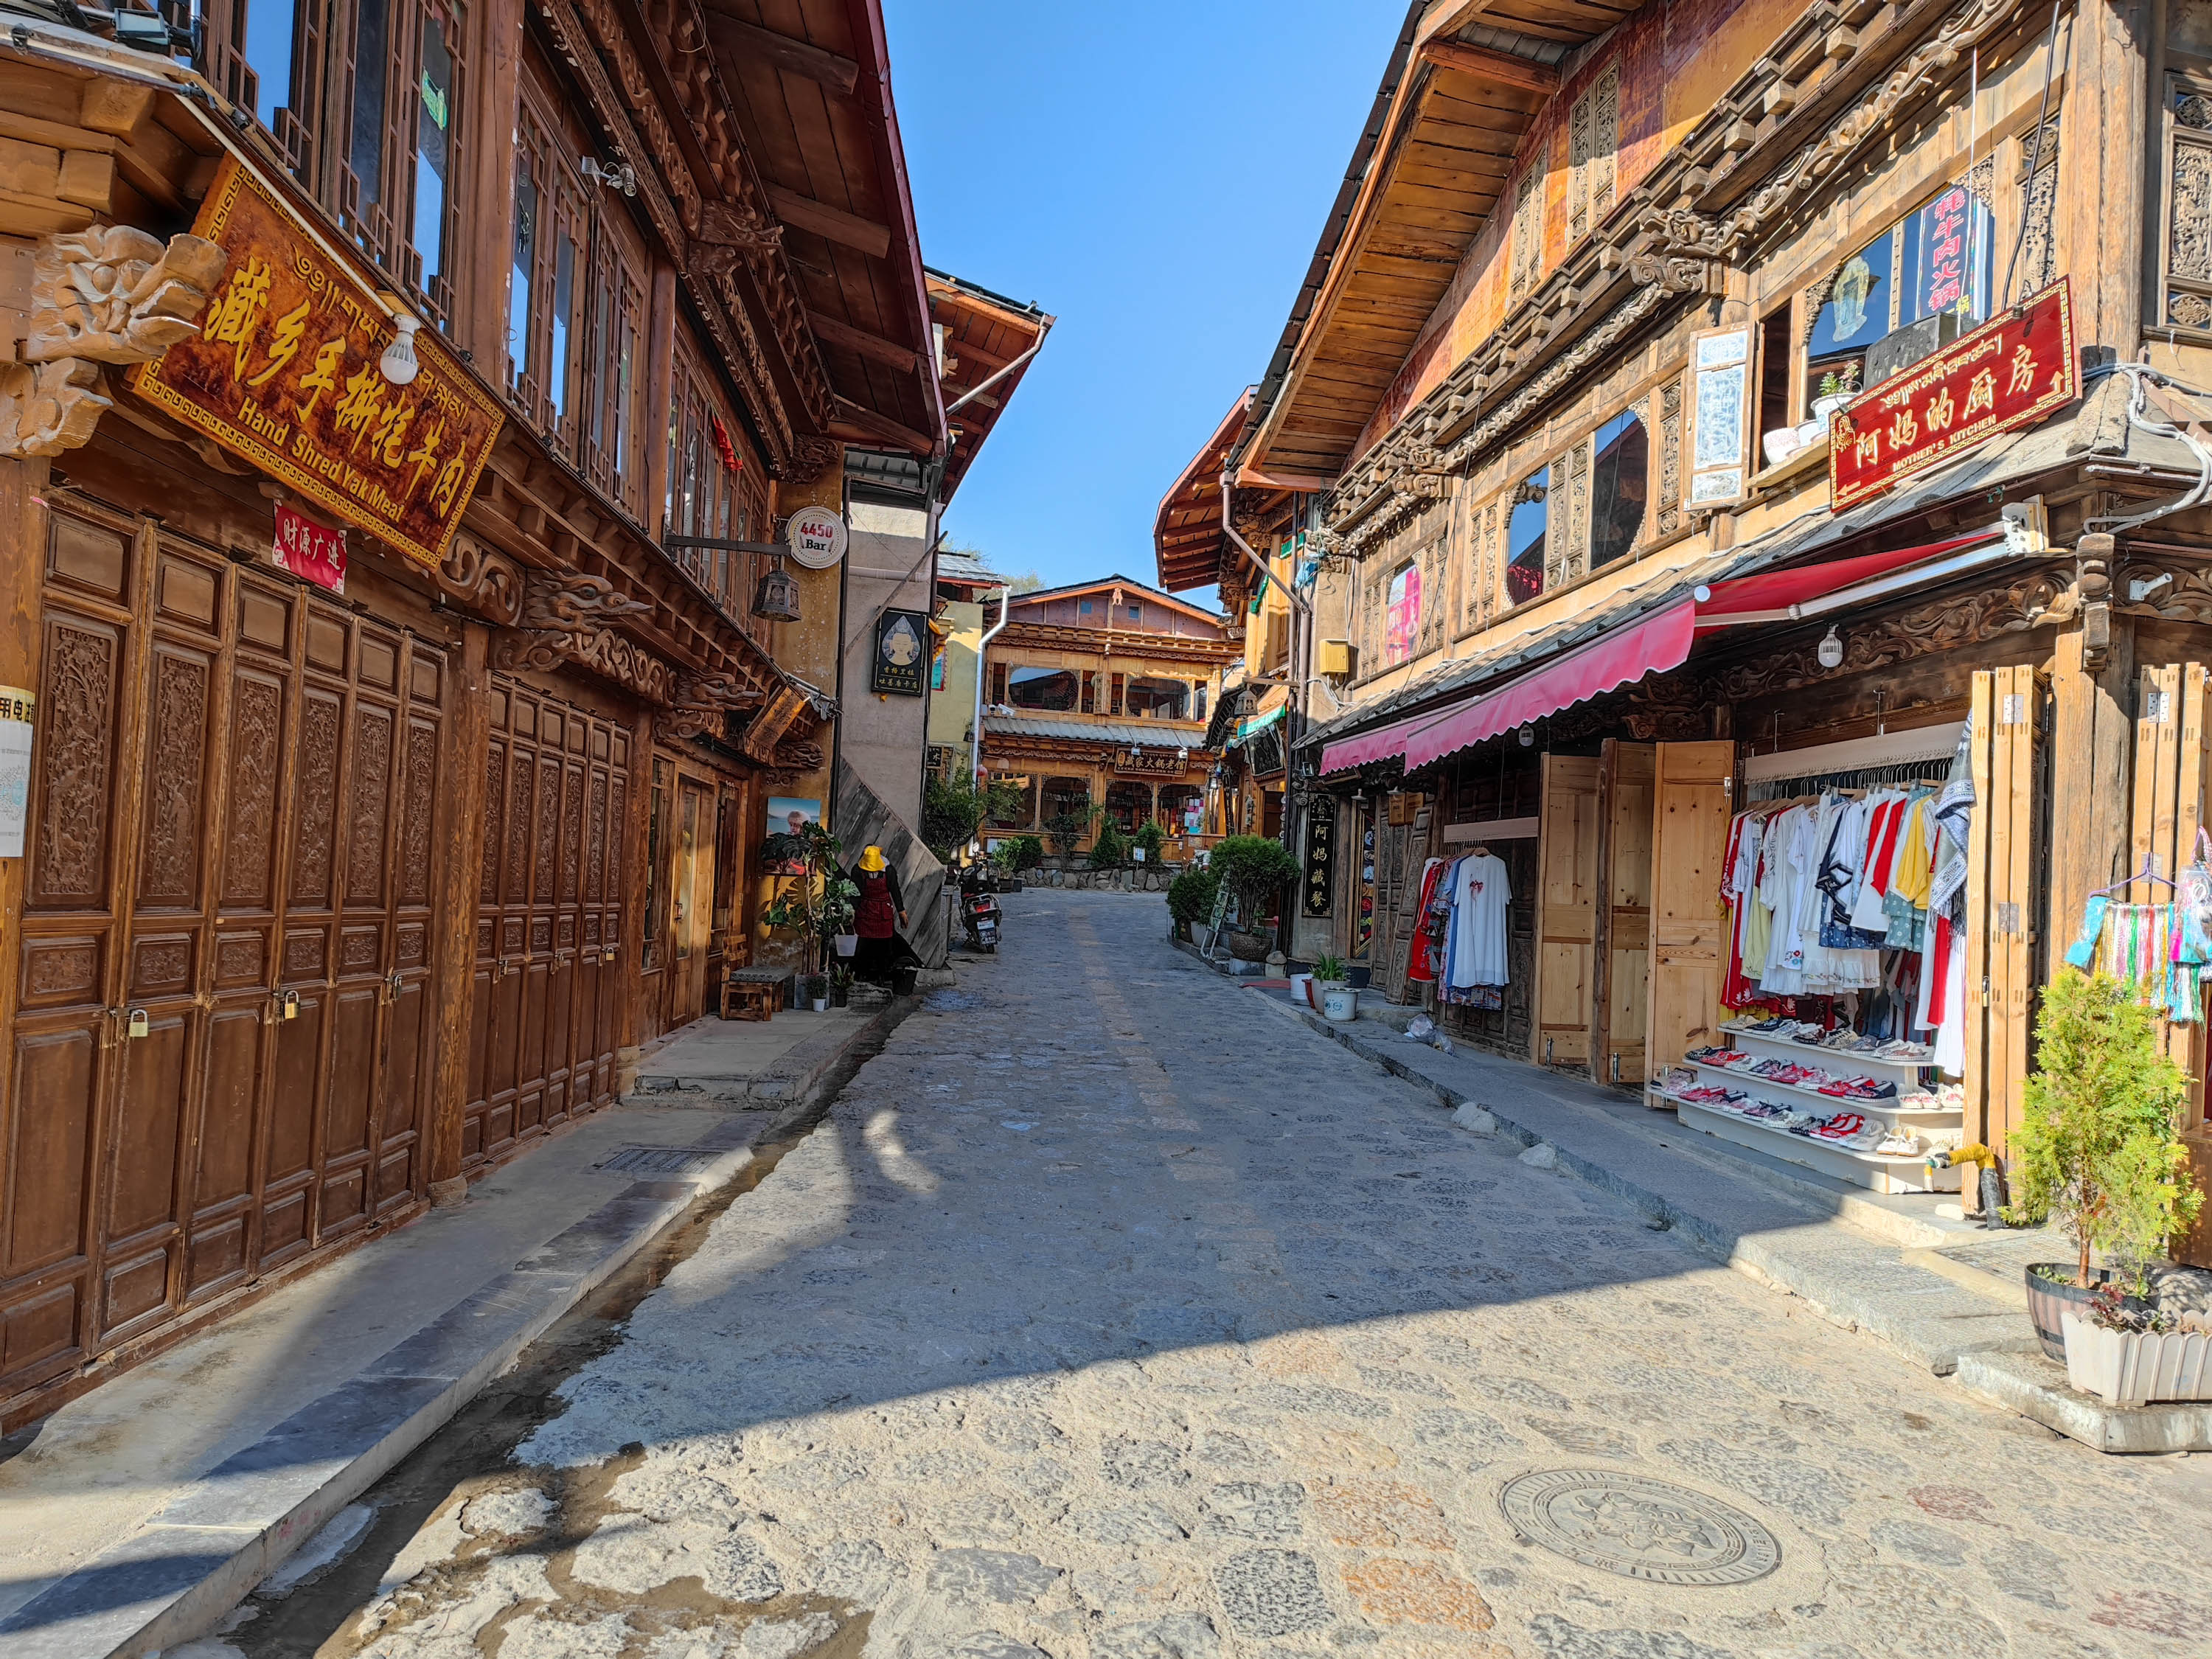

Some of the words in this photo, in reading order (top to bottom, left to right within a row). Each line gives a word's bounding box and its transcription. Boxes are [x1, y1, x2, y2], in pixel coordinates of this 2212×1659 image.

[1928, 188, 1965, 311] 牦牛肉火锅
[204, 255, 466, 518] 藏乡手撕牦牛肉
[1857, 344, 2038, 469] 阿妈的厨房
[237, 397, 290, 447] Hand
[292, 433, 342, 481] Shred
[341, 465, 369, 501] Yak
[369, 484, 405, 523] Meat
[1893, 439, 1944, 473] MOTHER'S
[1950, 414, 1997, 445] KITCHEN
[284, 518, 340, 571] 财源广进
[801, 522, 833, 538] 4450
[805, 538, 827, 551] Bar
[1310, 824, 1329, 908] 阿妈藏餐
